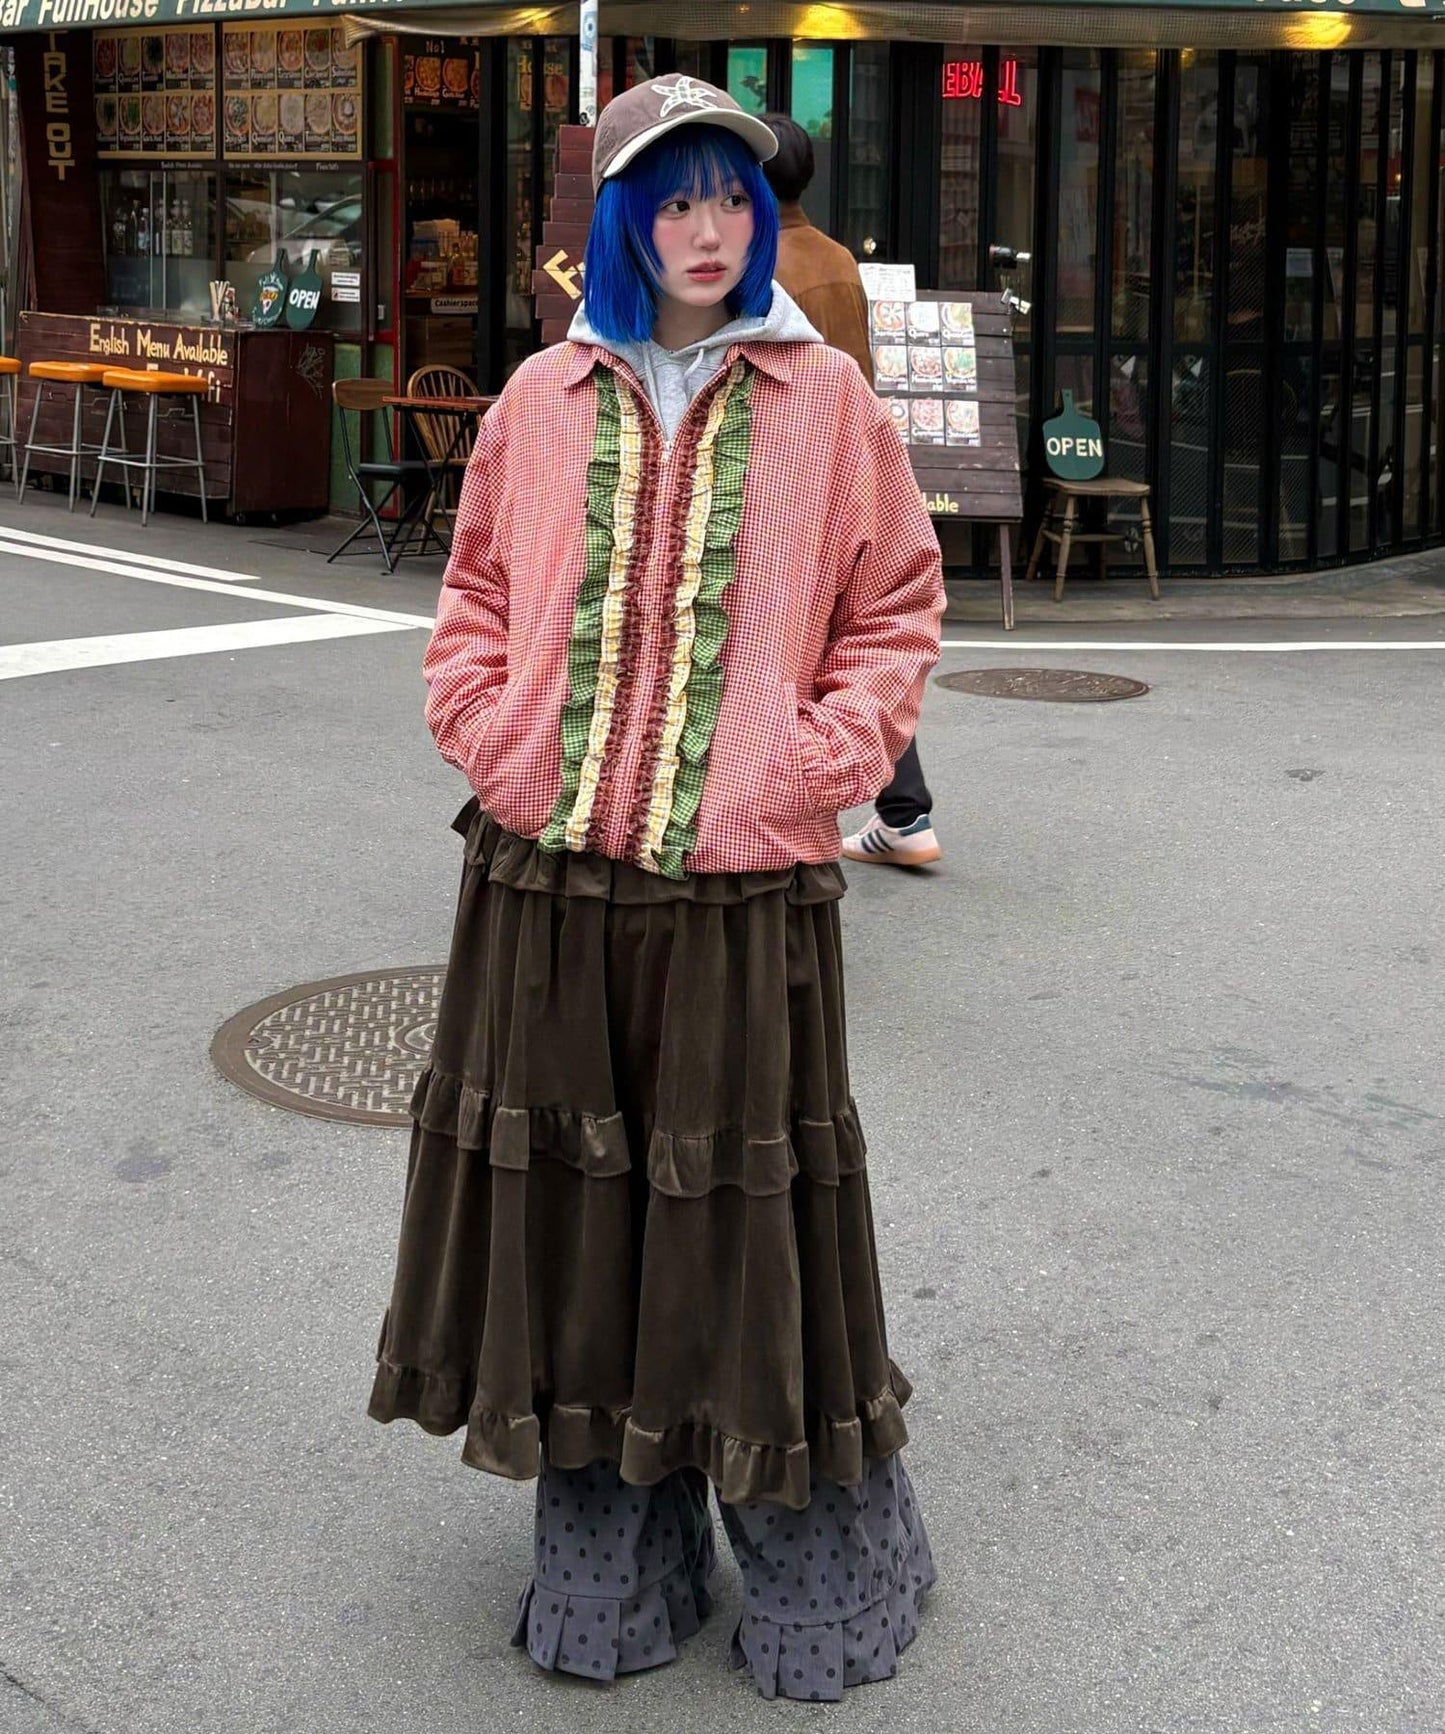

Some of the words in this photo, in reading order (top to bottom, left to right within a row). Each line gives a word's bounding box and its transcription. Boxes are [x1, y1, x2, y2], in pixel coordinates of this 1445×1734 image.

[0, 0, 29, 27] ar
[176, 0, 288, 15] Pizza
[41, 29, 69, 113] TAKE
[46, 122, 76, 182] OUT
[289, 288, 321, 310] OPEN
[89, 322, 130, 356] English
[136, 328, 170, 360] Menu
[172, 332, 229, 366] Available
[1046, 437, 1103, 459] OPEN
